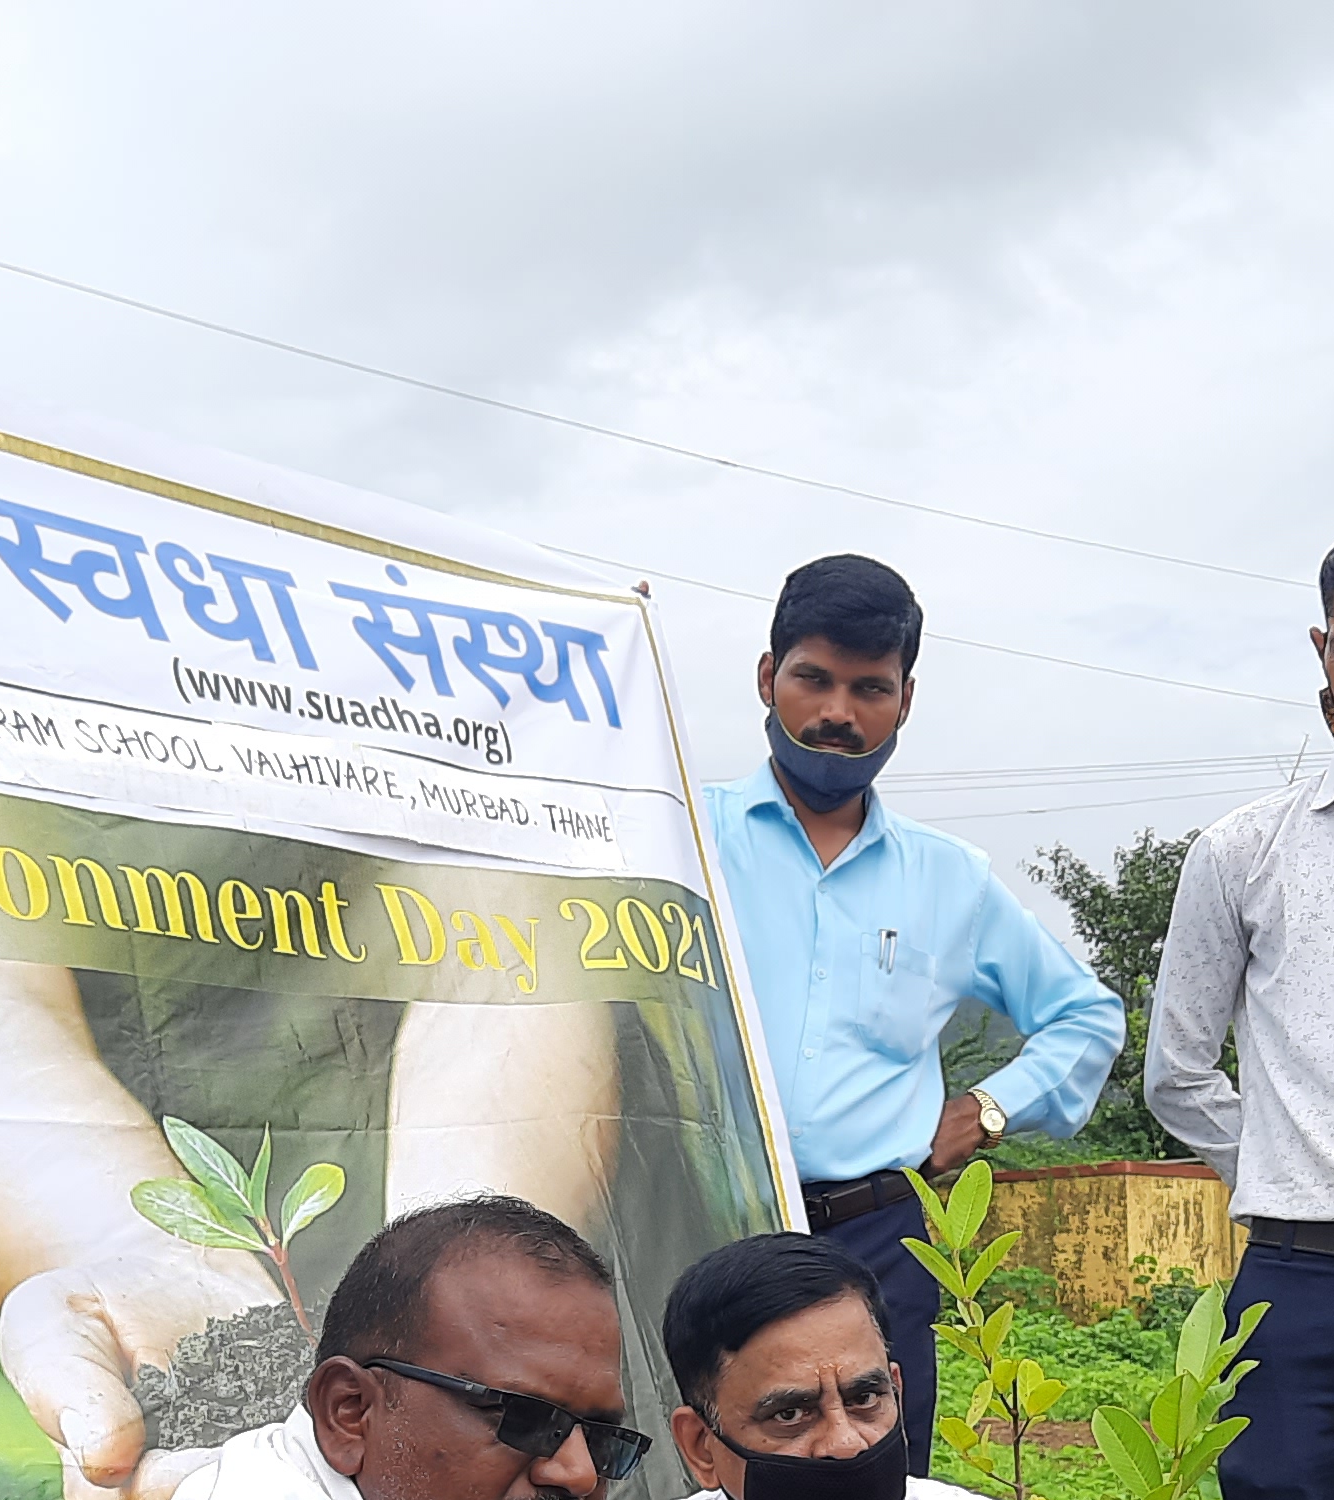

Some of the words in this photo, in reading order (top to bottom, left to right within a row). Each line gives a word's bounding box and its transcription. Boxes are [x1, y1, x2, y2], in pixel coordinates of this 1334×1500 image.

[326, 564, 623, 730] संस्था
[173, 656, 513, 766] (www.suadha.org)
[74, 718, 224, 773] SCHOOL
[542, 803, 614, 843] THANE
[374, 882, 540, 995] Day
[559, 897, 720, 991] 2021
